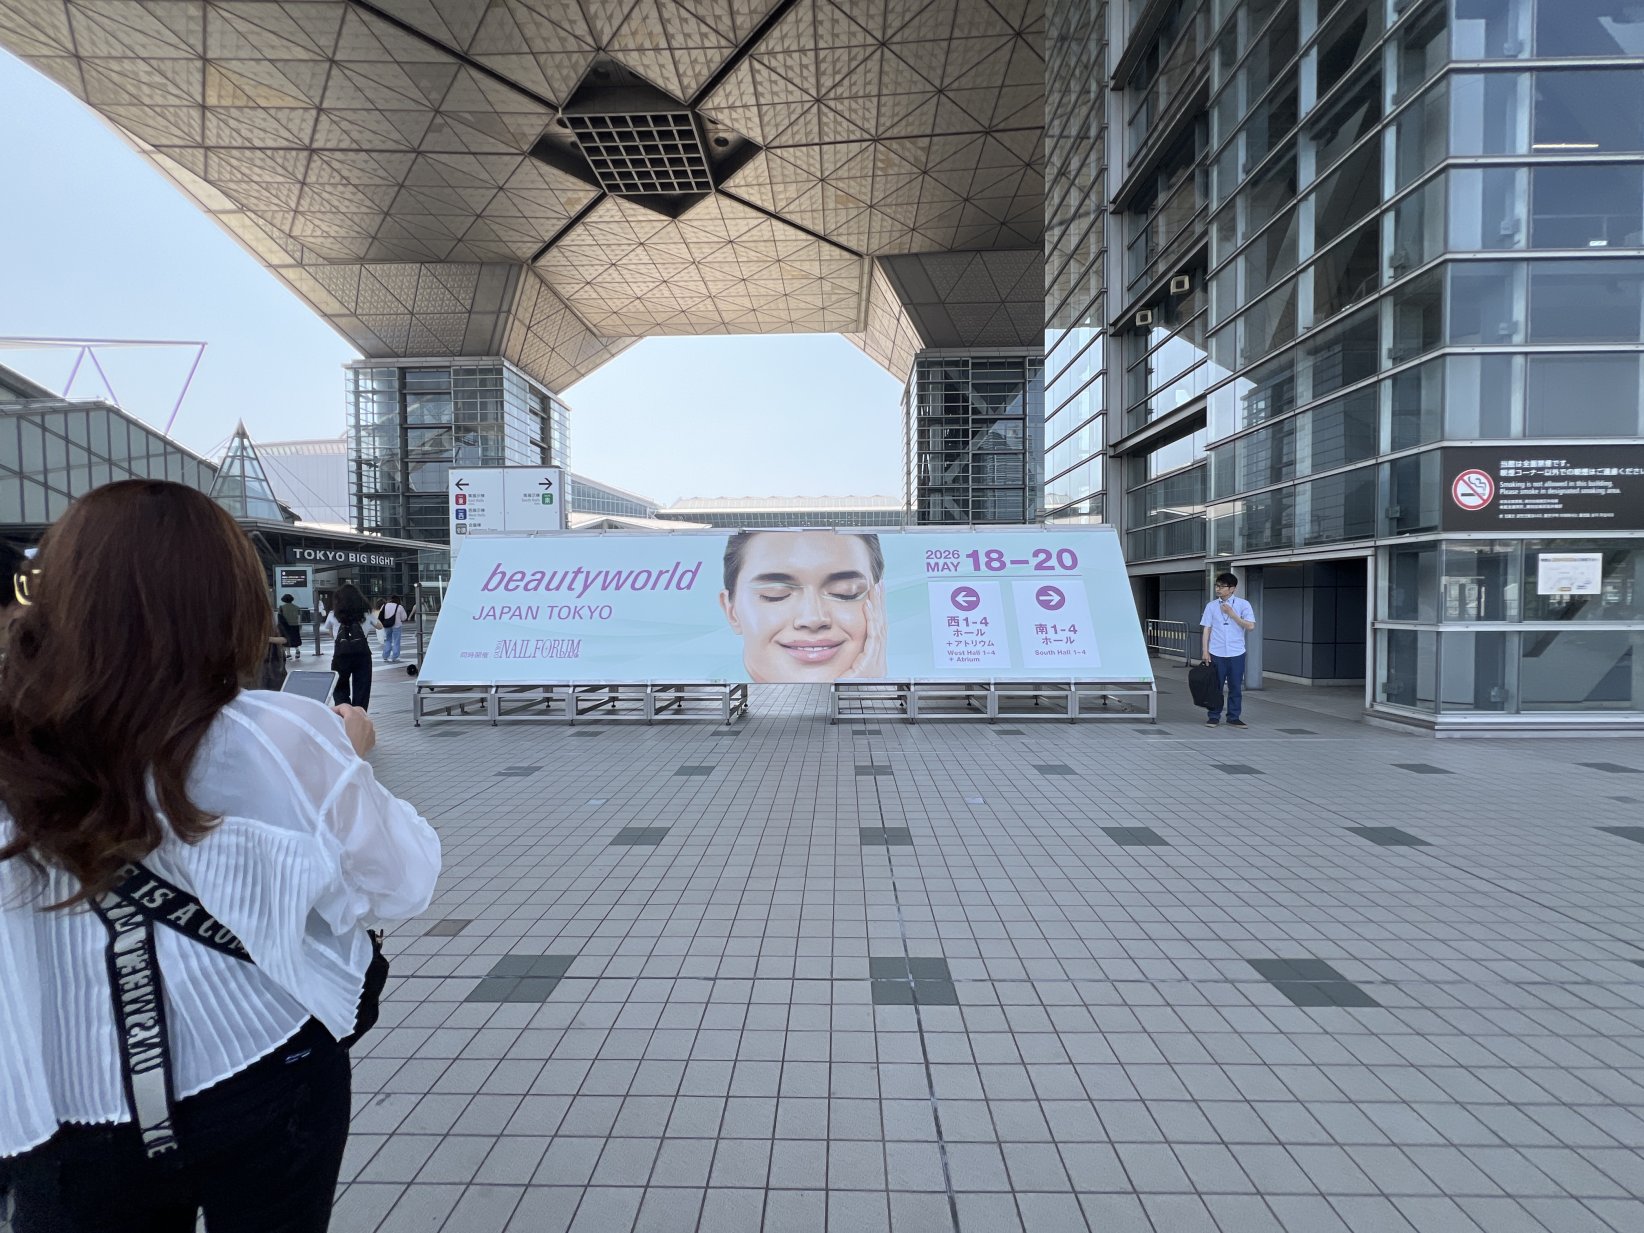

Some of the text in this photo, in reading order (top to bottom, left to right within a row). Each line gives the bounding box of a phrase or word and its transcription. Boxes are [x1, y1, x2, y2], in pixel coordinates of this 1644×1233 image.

[1500, 481, 1525, 489] Smoking
[292, 548, 394, 566] TOKYO BIG SIGHT
[925, 549, 961, 560] 2026
[926, 562, 961, 573] MAY
[481, 561, 703, 599] beautyworld
[472, 605, 613, 621] JAPAN TOKYO
[952, 628, 986, 637] ホール
[1042, 636, 1076, 646] ホール
[500, 639, 531, 659] NAIL
[130, 880, 176, 908] IS
[166, 902, 200, 927] A
